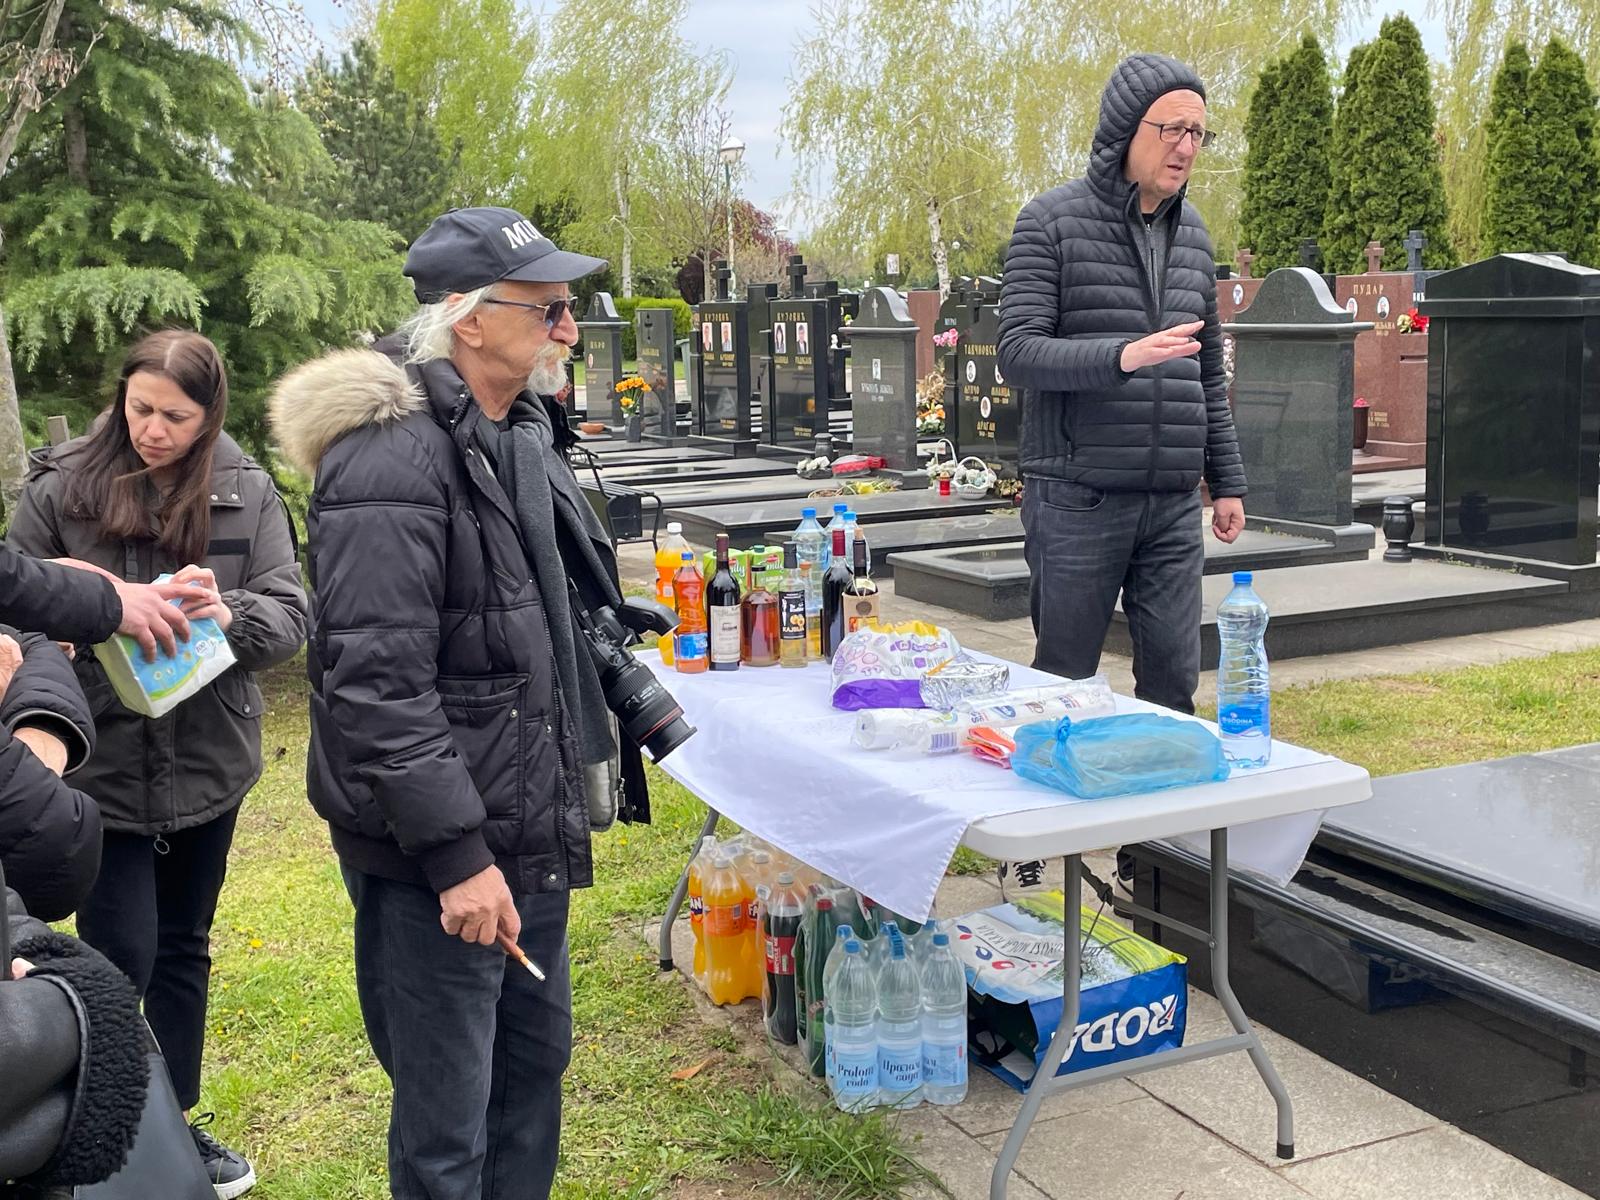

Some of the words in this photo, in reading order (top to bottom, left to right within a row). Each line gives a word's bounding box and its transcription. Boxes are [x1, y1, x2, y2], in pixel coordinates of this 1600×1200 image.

[1353, 284, 1384, 295] ПУДАР
[838, 1063, 874, 1078] Prolom
[846, 1076, 869, 1087] voda
